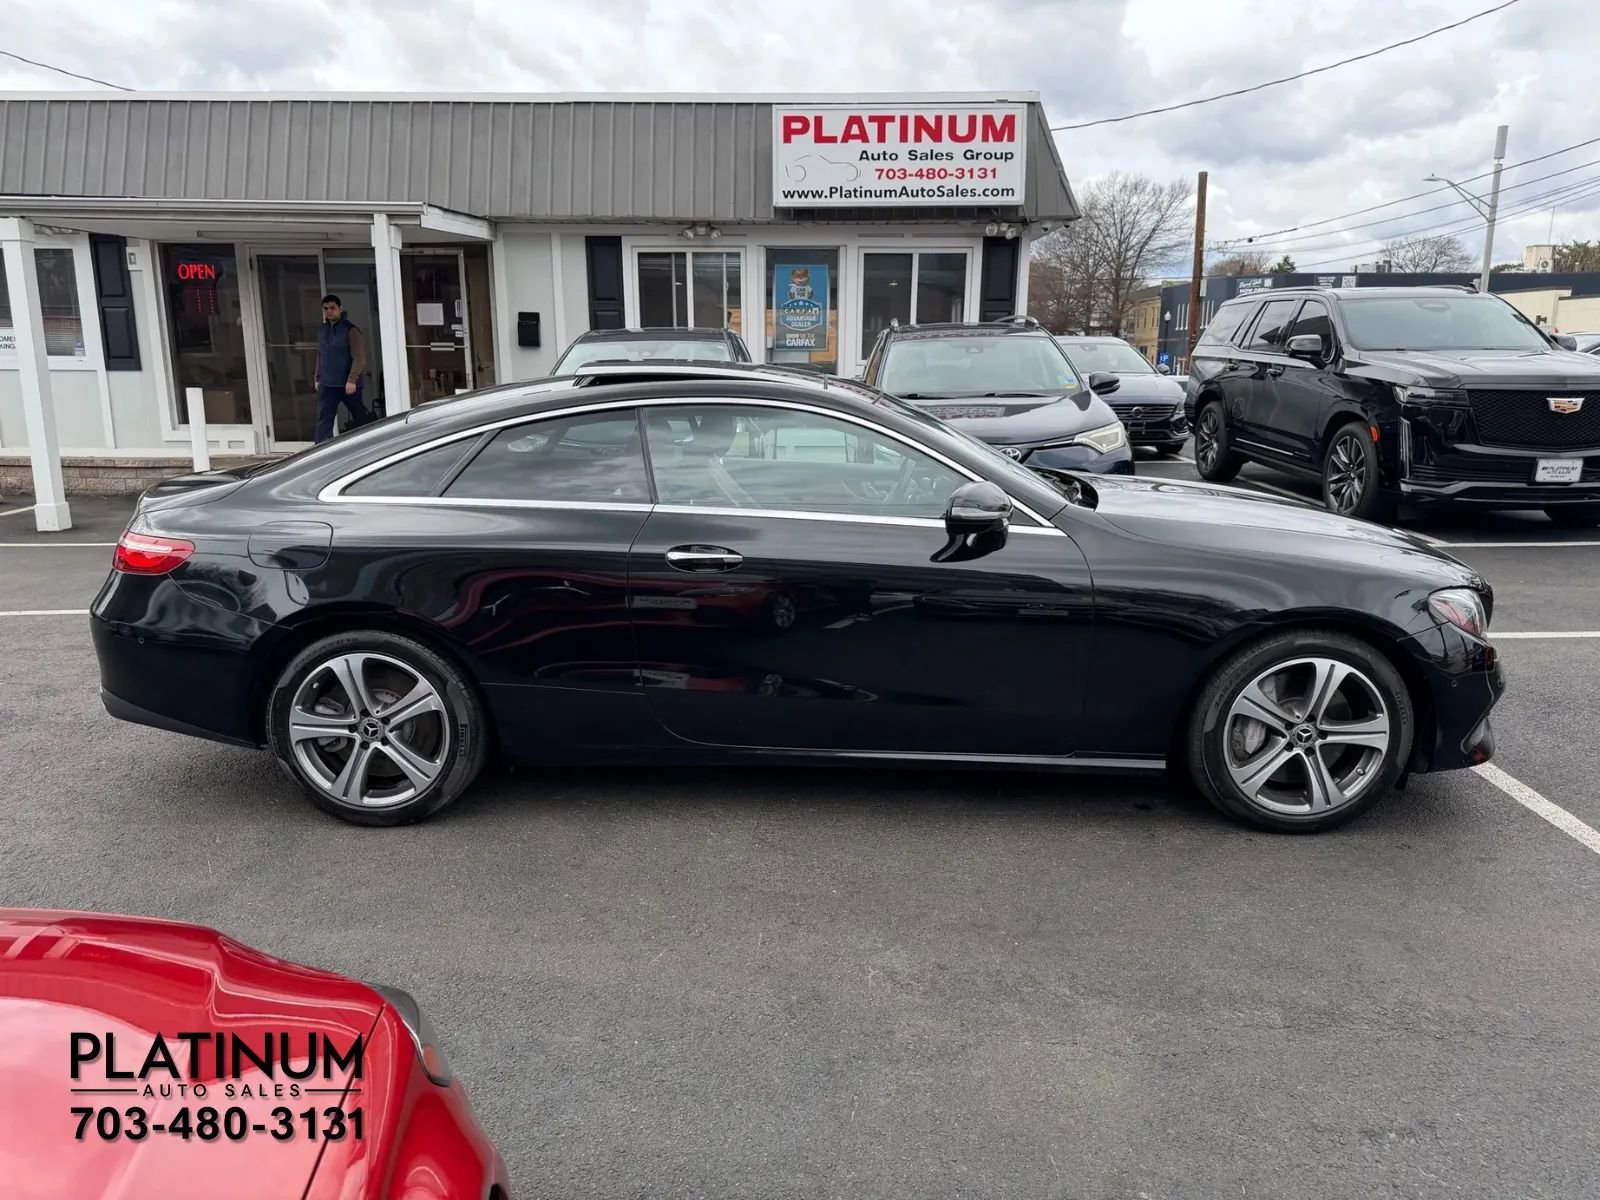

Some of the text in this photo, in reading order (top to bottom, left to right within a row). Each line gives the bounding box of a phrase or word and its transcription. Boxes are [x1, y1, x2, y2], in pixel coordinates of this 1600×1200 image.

[782, 114, 1016, 144] PLATINUM
[859, 149, 1014, 162] Auto Sales Group
[875, 168, 997, 180] 703-480-3131
[782, 185, 1015, 199] www.PlatinumAutoSales.com
[177, 263, 216, 280] OPEN
[786, 338, 815, 347] CARFAX
